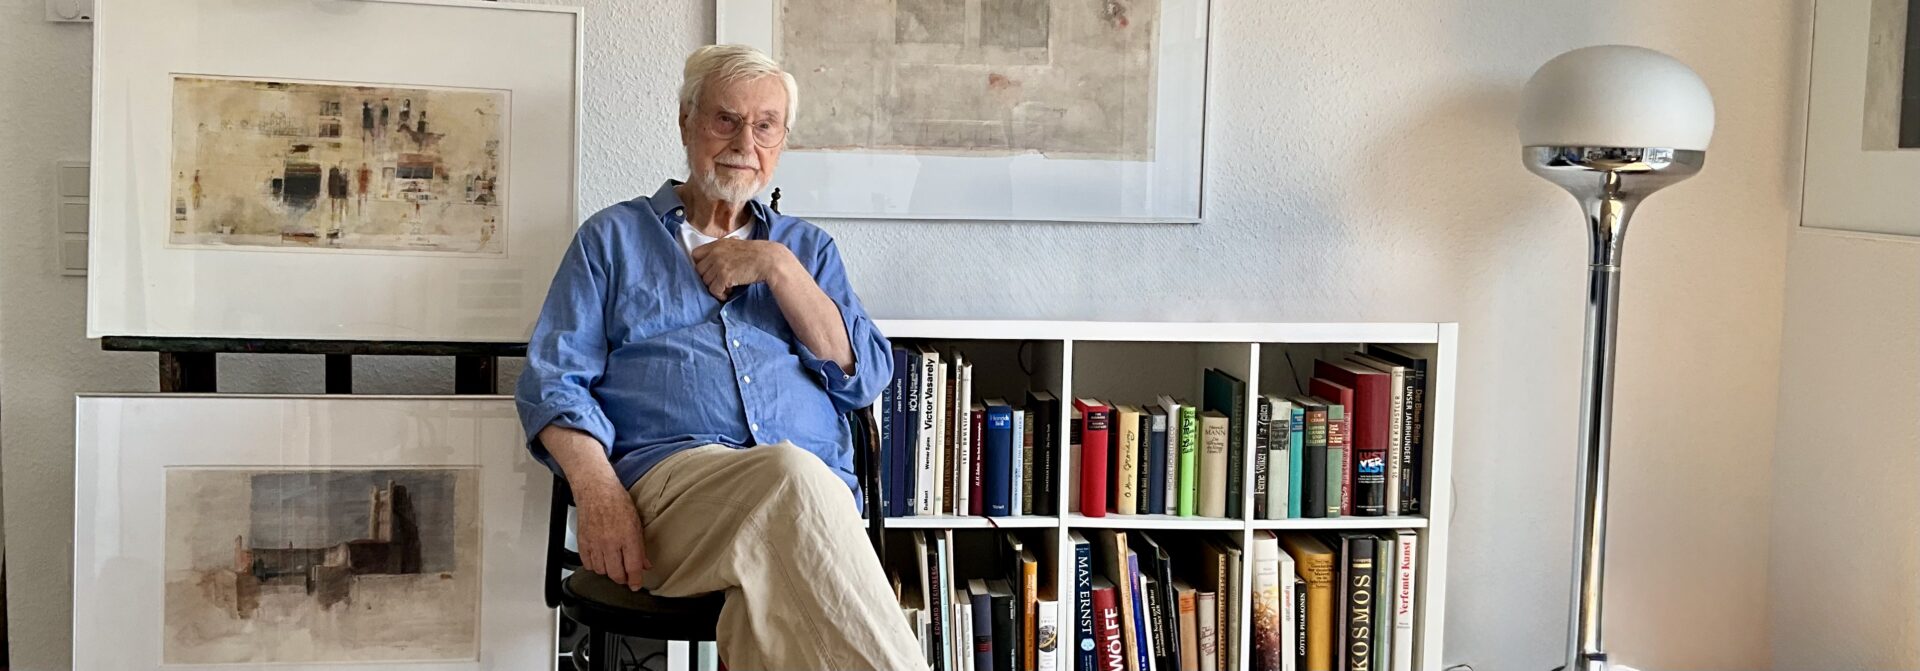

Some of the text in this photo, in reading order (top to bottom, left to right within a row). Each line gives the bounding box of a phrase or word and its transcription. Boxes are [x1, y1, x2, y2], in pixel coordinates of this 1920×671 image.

[908, 390, 918, 412] KÖLN
[924, 358, 936, 430] Victor Vasarely
[1414, 403, 1422, 424] Blaue
[1232, 436, 1240, 448] de
[1404, 412, 1413, 464] JAHRHUNDERT
[1232, 450, 1240, 483] monde
[1358, 464, 1385, 473] LUST
[1360, 452, 1386, 460] LUST
[1360, 457, 1384, 468] VER
[1231, 484, 1239, 494] le
[1254, 474, 1265, 494] Ferne
[1401, 542, 1410, 570] Kunst
[932, 566, 940, 605] STEINBERG
[1078, 556, 1090, 587] MAX
[1399, 572, 1410, 614] Verfemte
[1080, 590, 1092, 634] ERNST
[1352, 574, 1370, 671] KOSMOS
[1104, 606, 1123, 671] WÖLFE
